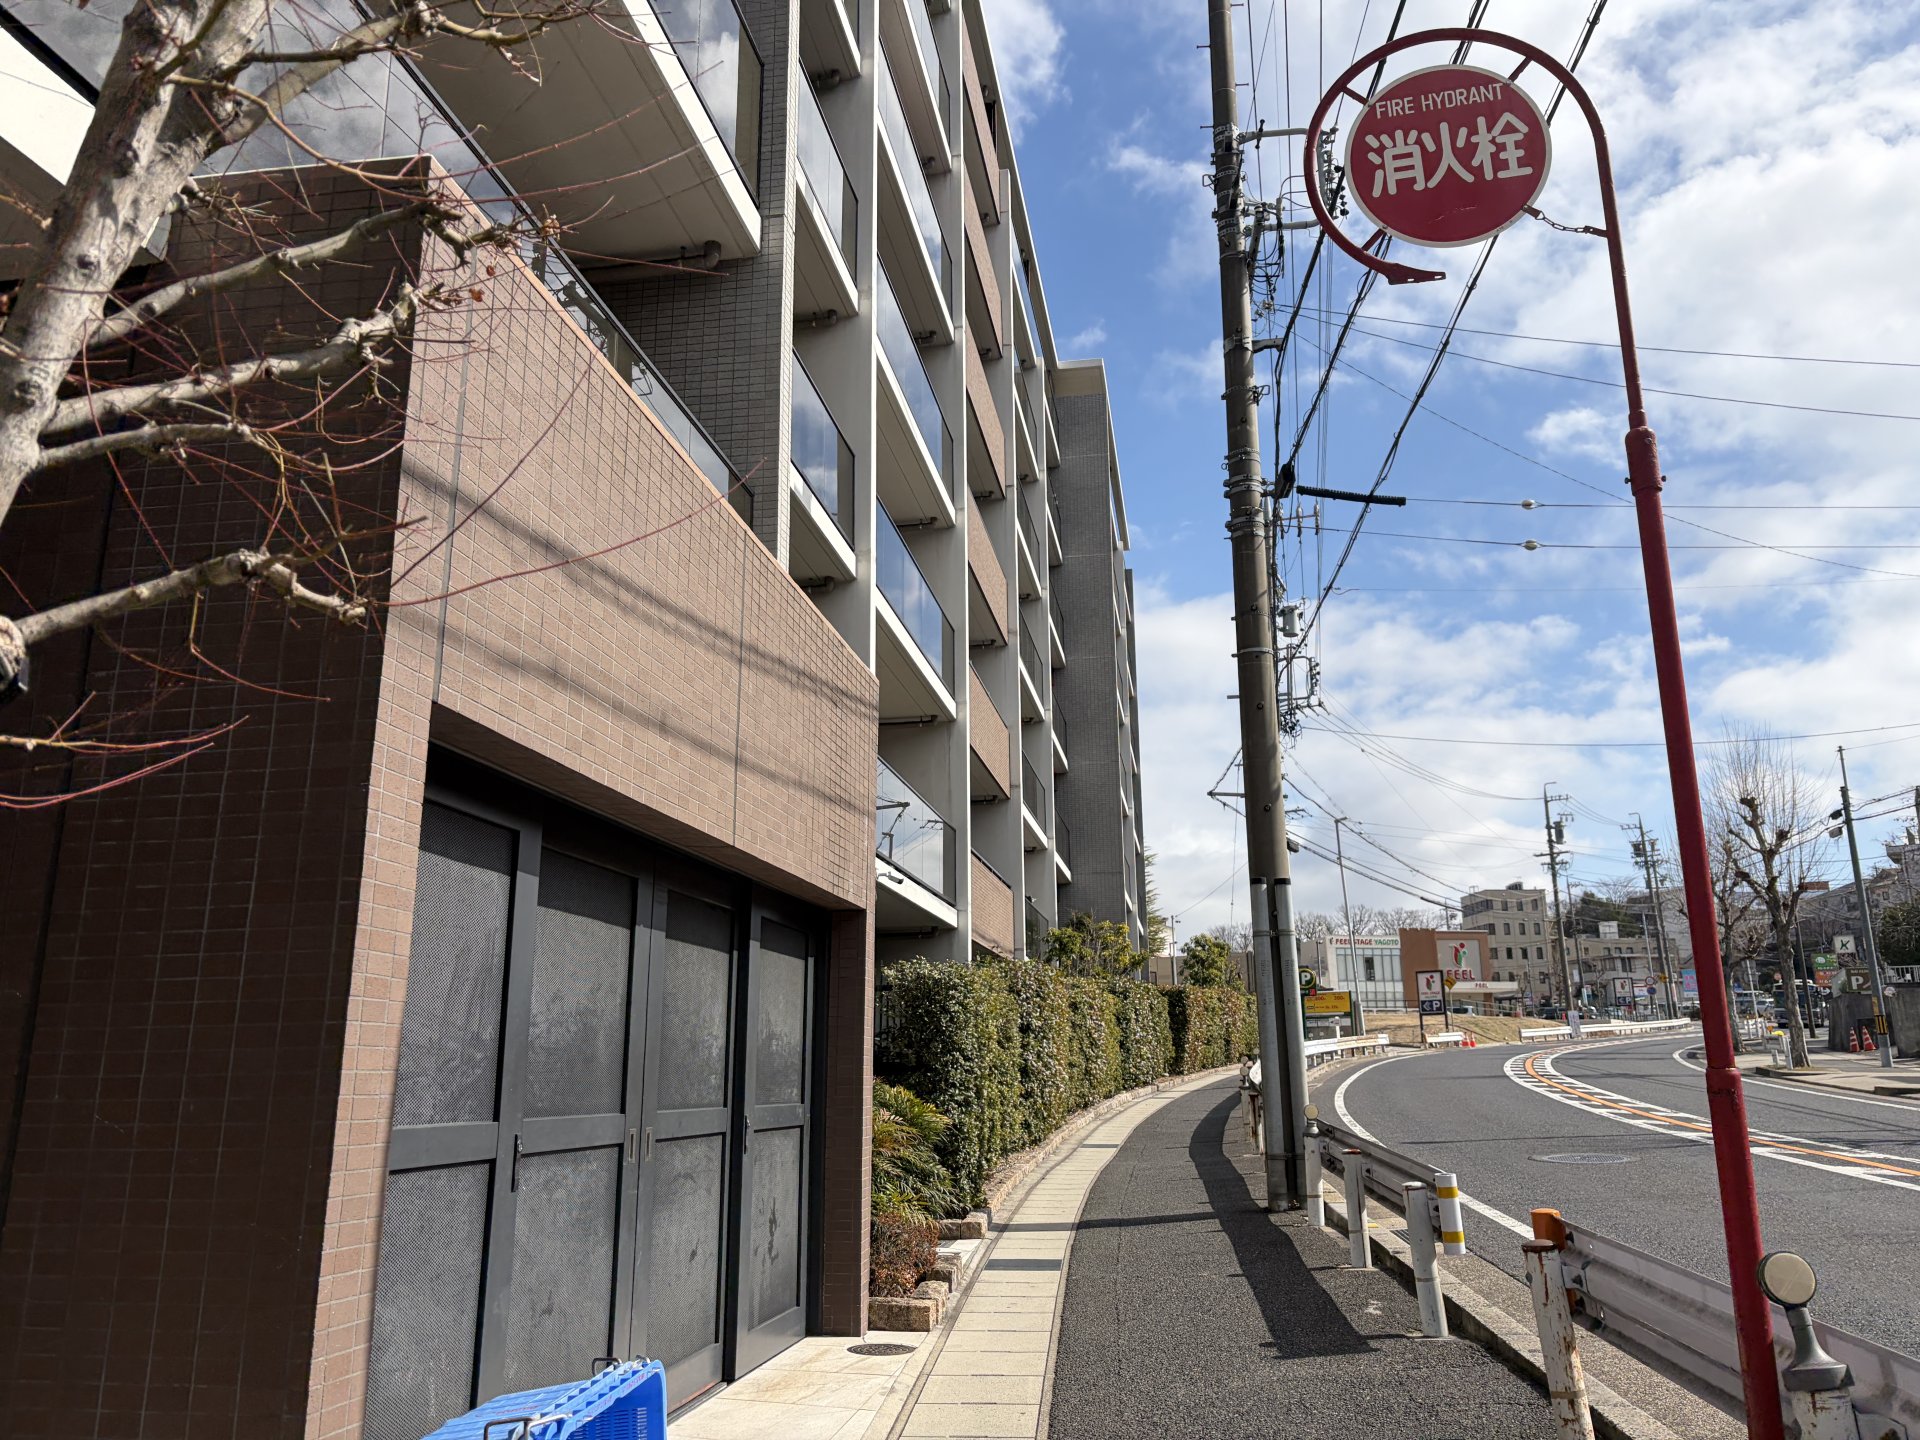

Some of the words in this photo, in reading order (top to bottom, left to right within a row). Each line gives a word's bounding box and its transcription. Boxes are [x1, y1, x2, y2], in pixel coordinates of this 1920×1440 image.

[1375, 96, 1415, 119] FIRE
[1420, 82, 1504, 112] HYDRANT
[1365, 111, 1533, 198] 消火栓
[1374, 938, 1399, 946] YAGOTO
[1301, 972, 1311, 985] P
[1446, 969, 1475, 980] FEEL
[1851, 975, 1864, 990] P
[1432, 1000, 1441, 1011] P
